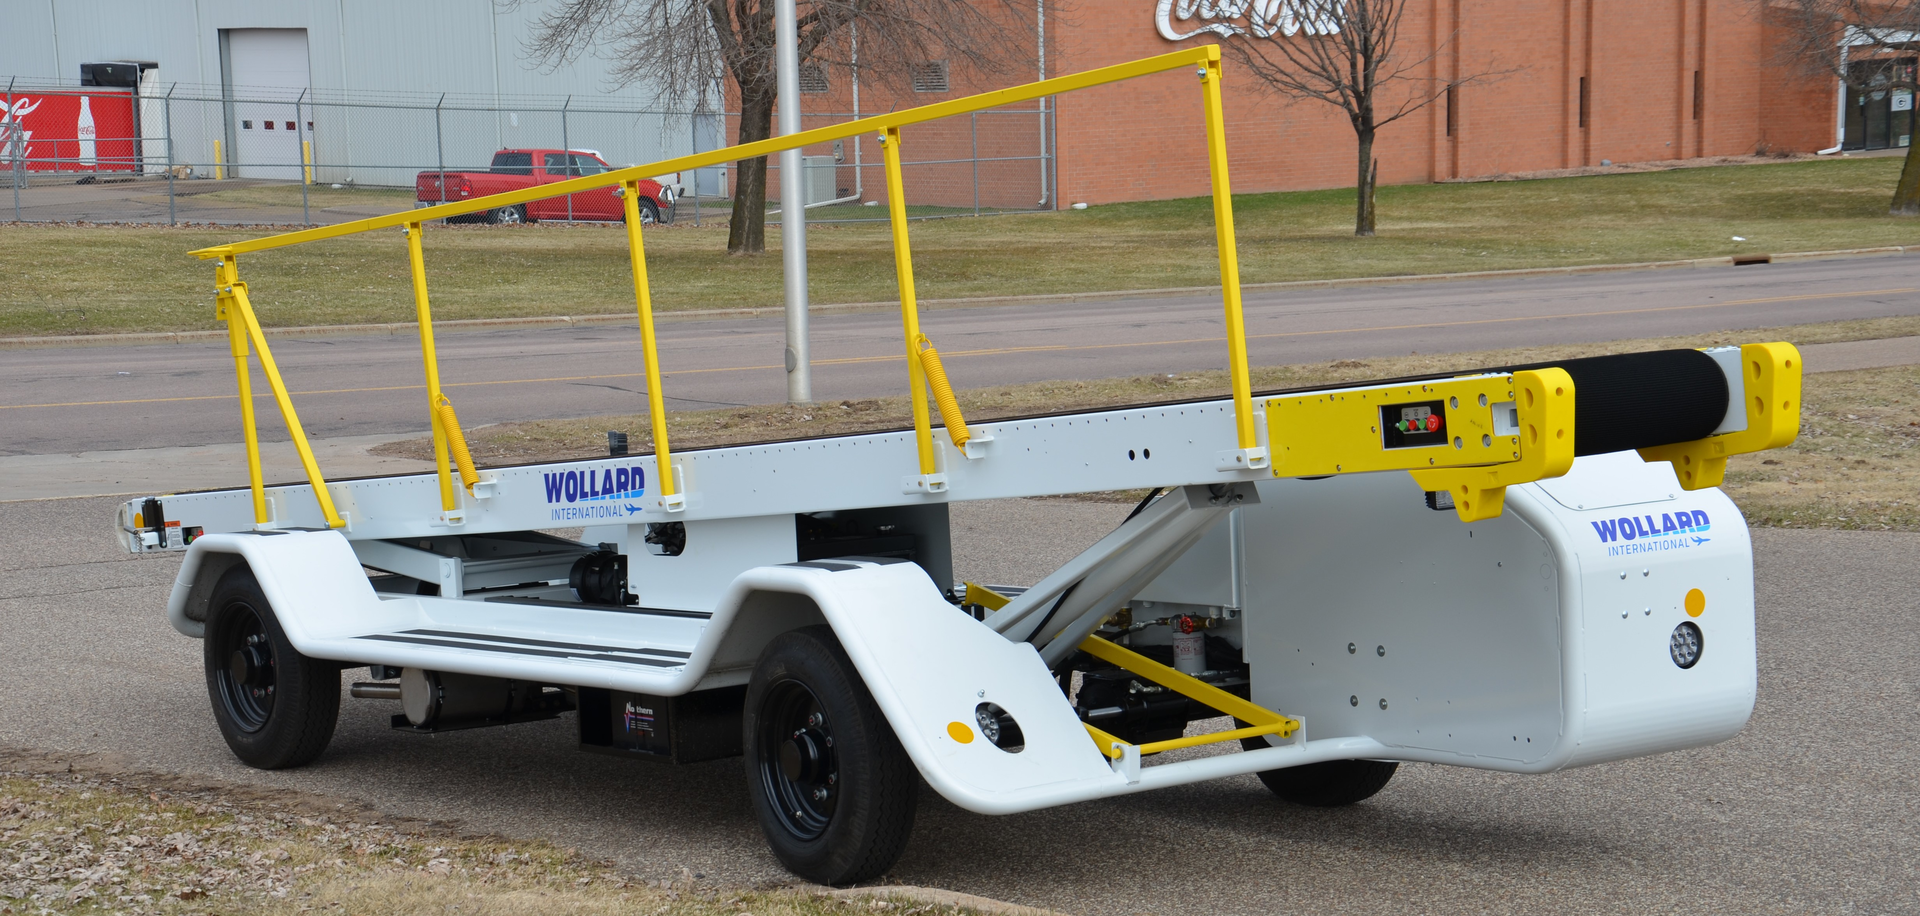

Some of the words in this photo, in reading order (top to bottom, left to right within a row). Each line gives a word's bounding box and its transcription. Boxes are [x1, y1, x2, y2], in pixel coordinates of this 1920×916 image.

[543, 466, 645, 503] WOLLARD
[551, 505, 623, 520] INTERNATIONAL
[1591, 510, 1711, 543] WOLLARD
[1608, 538, 1690, 556] INTERNATIONAL
[625, 701, 653, 715] Nothern
